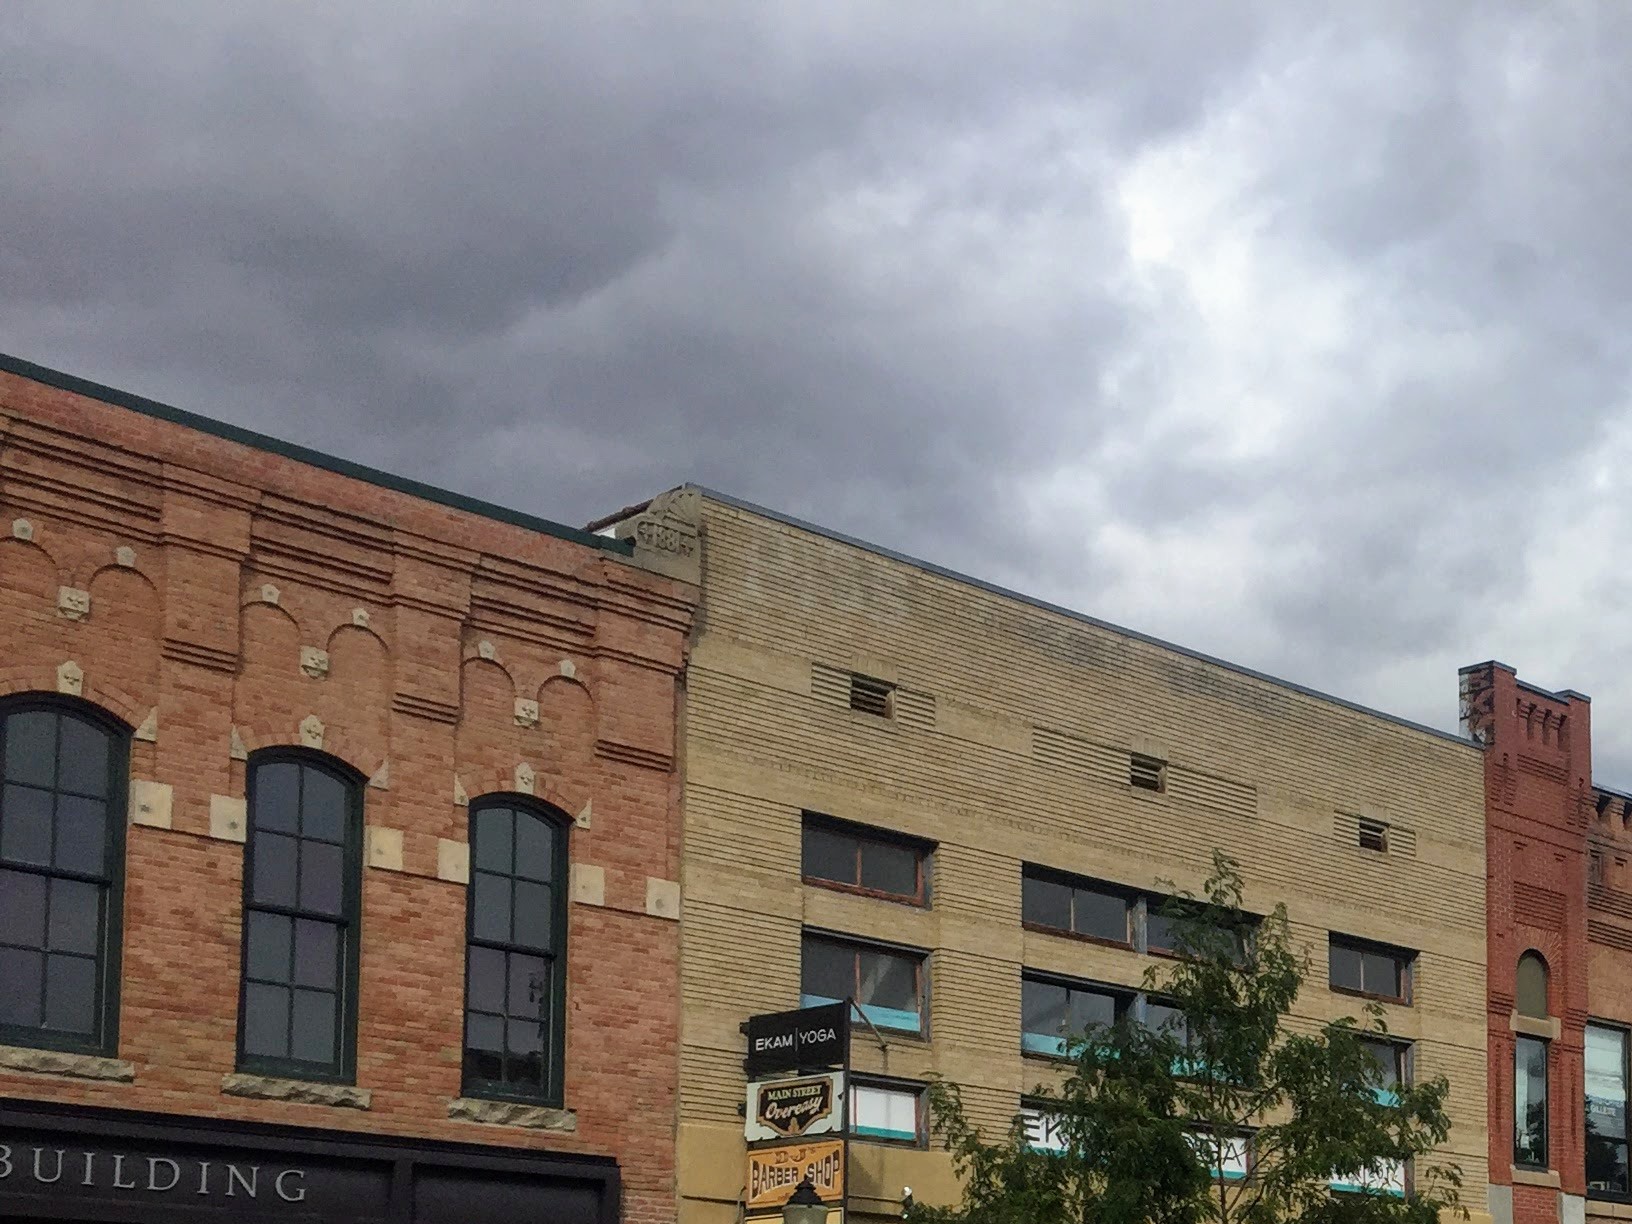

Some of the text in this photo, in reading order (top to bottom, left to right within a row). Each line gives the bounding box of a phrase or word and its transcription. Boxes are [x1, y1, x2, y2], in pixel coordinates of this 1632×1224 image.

[755, 1028, 837, 1051] EKAM YOGA
[767, 1084, 823, 1101] MAIN STREET
[765, 1096, 823, 1119] Overeasy
[751, 1149, 840, 1199] BARBER SHOP
